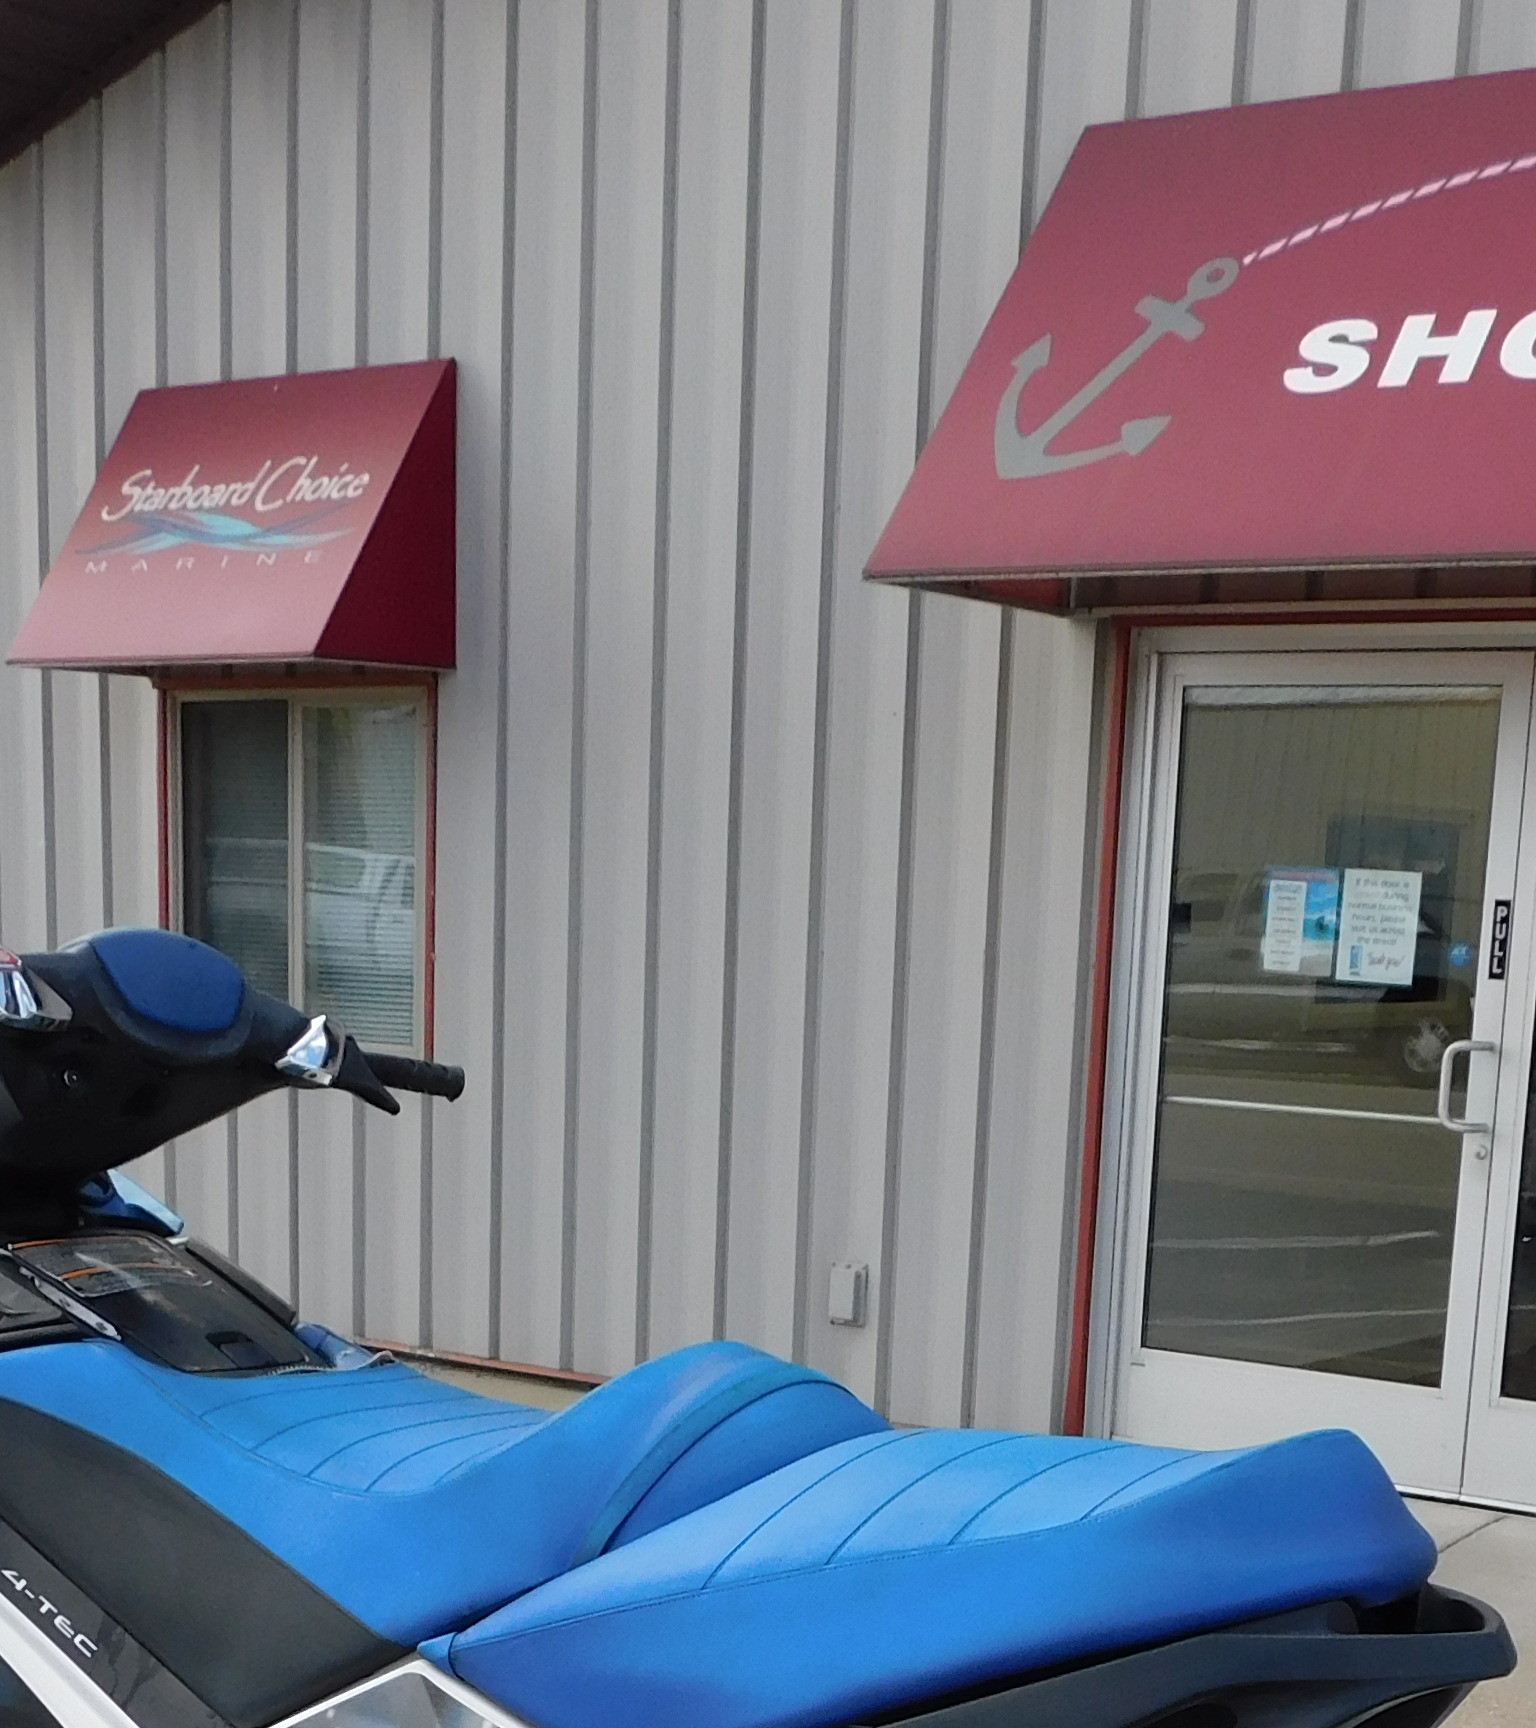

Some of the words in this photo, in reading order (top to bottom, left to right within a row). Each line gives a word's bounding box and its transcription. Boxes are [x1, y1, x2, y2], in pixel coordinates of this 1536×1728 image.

[101, 460, 272, 521] Starboard
[254, 455, 370, 512] Choice
[84, 551, 322, 574] MARINE
[1492, 906, 1508, 974] PULL
[1, 1568, 99, 1658] 4-TEC
